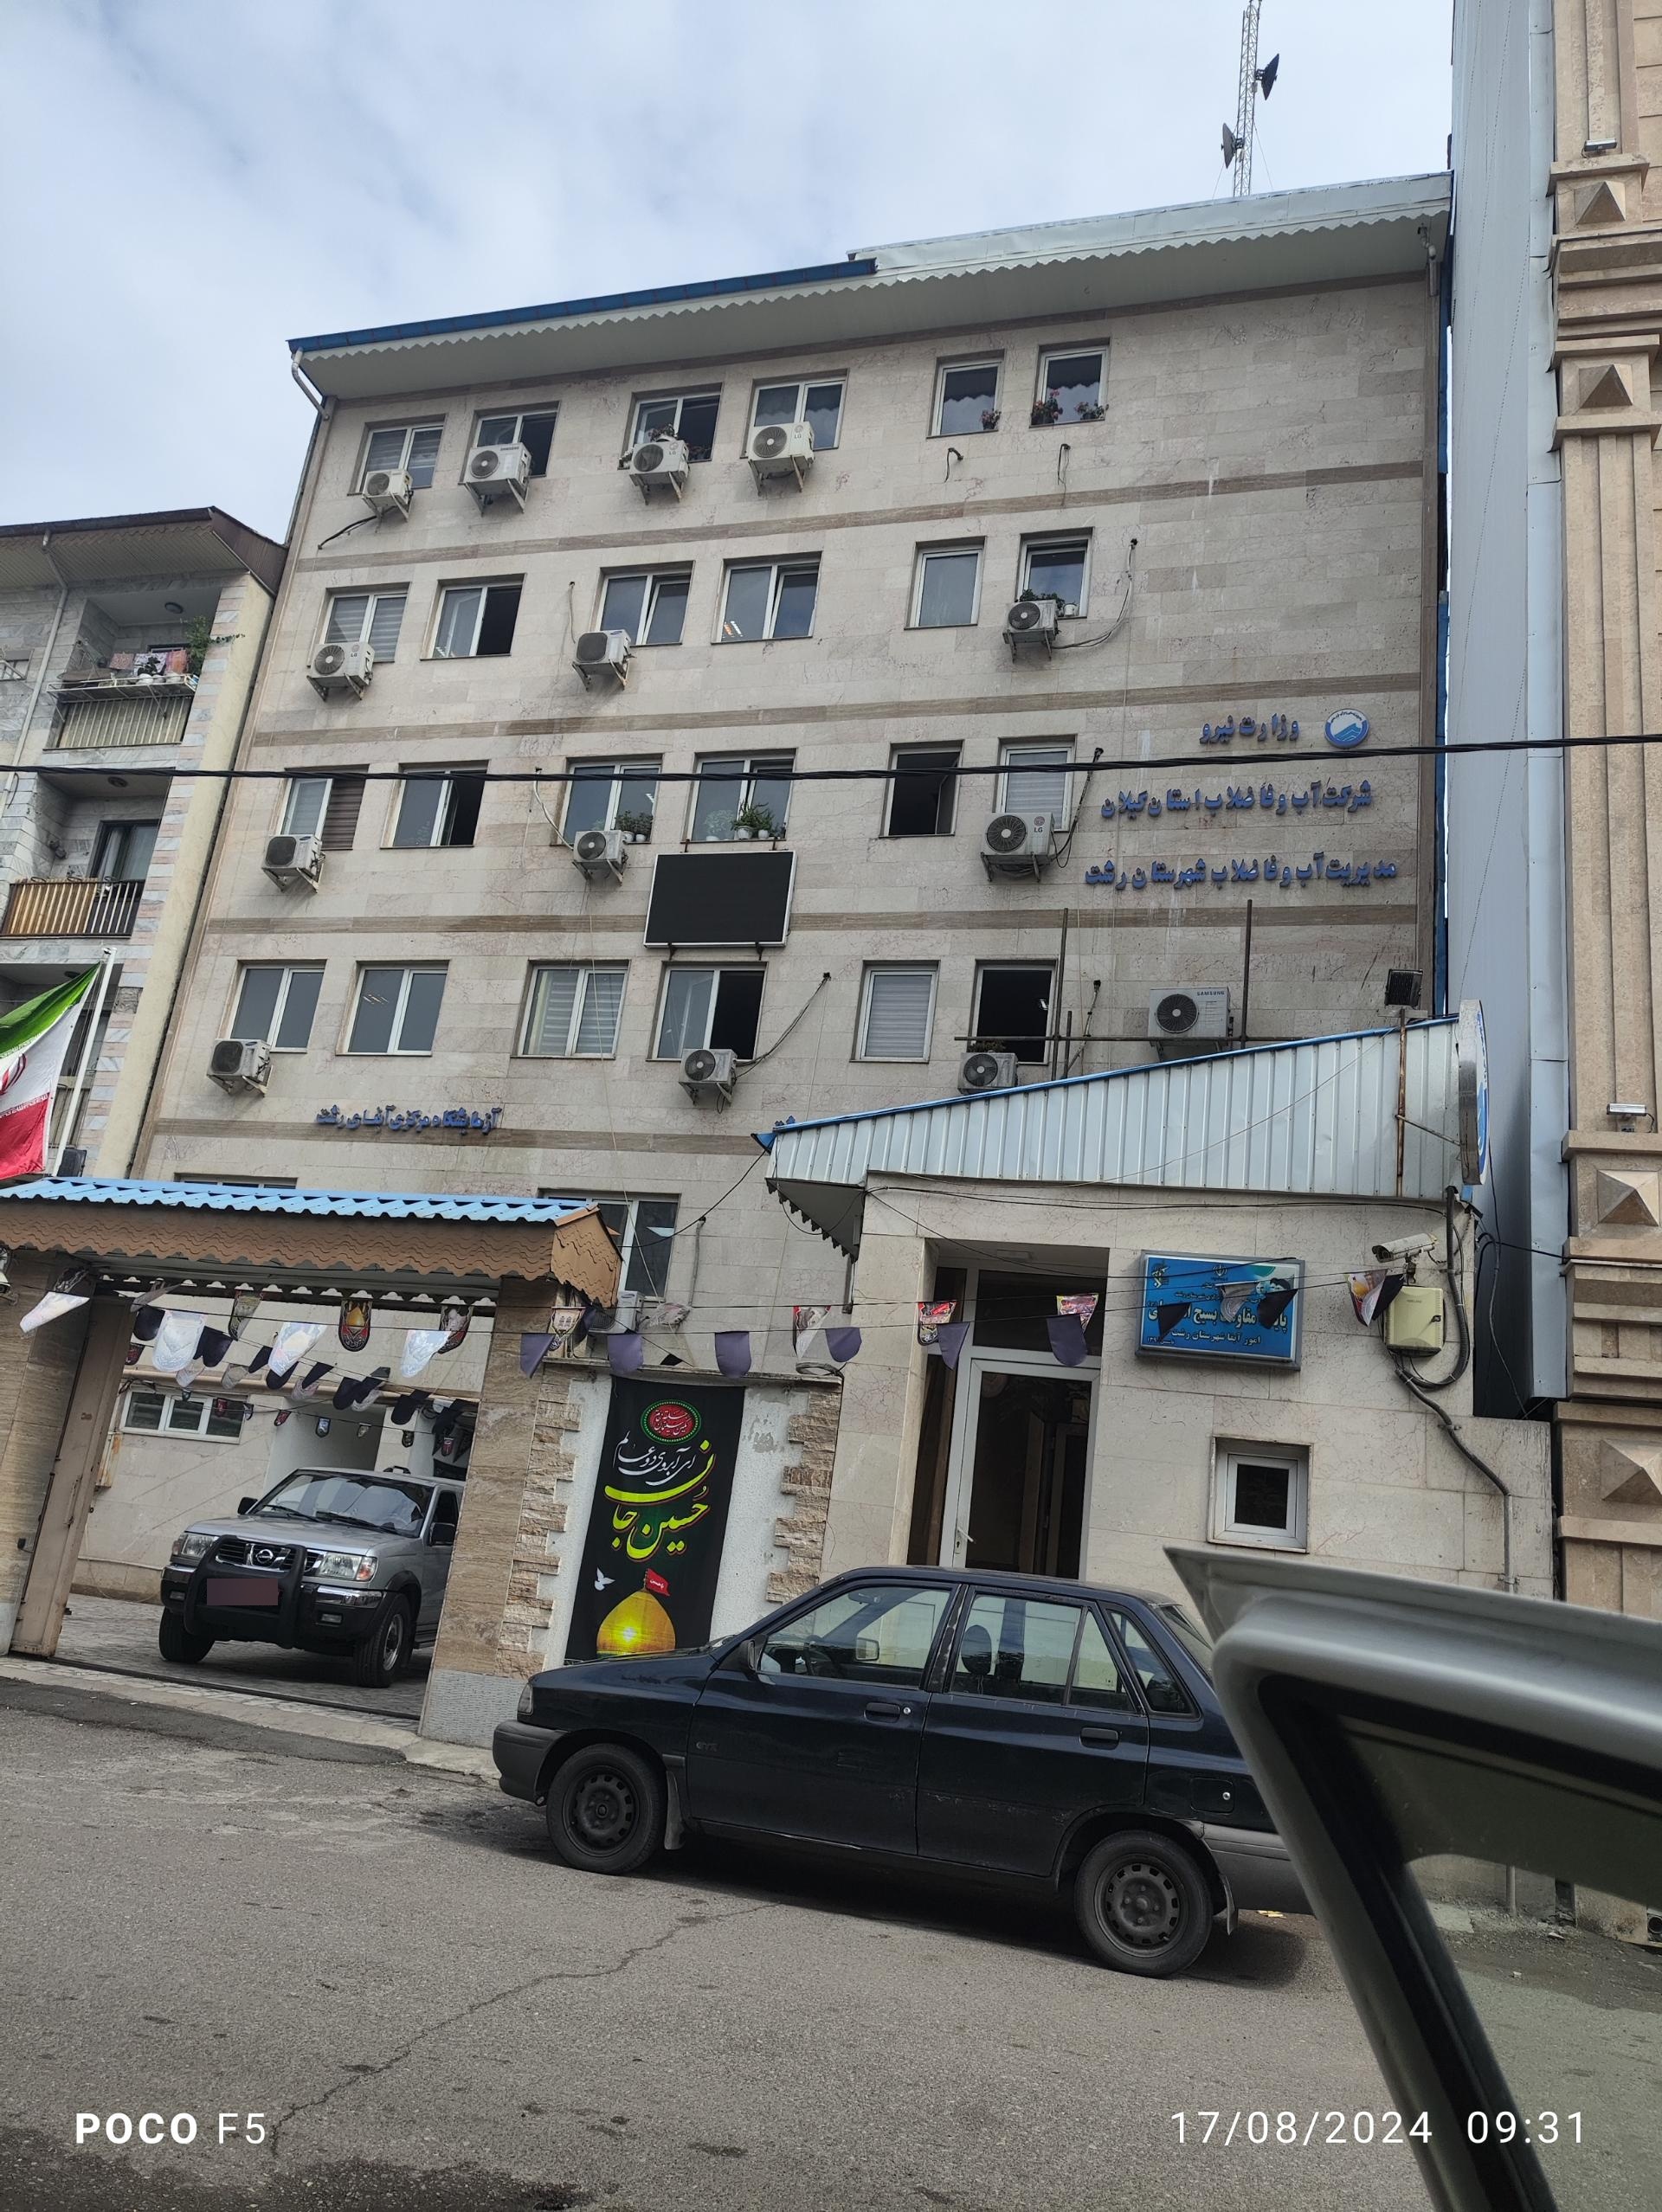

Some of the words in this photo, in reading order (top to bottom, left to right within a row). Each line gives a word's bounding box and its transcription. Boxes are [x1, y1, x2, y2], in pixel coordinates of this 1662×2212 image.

[1199, 715, 1235, 744] نیرو
[1239, 712, 1299, 742] وزارت
[1148, 788, 1201, 817] استان
[1204, 782, 1274, 817] فاضلاب
[1276, 794, 1287, 815] و
[1292, 781, 1321, 815] آب
[1322, 780, 1372, 813] شرکت
[1085, 859, 1126, 891] رشت
[1132, 858, 1206, 889] شهرستان
[1212, 854, 1278, 890] فاضلاب
[1279, 866, 1292, 888] و
[1296, 852, 1324, 888] آب
[1325, 858, 1397, 887] مدیریت
[316, 1104, 345, 1129] رشت
[433, 1107, 502, 1135] آزمایشگاه
[1194, 1308, 1218, 1325] بسیج
[1171, 1328, 1190, 1340] رشت
[1192, 1330, 1225, 1342] شهرستان
[612, 1431, 655, 1469] عالم
[618, 1445, 692, 1476] آبروی
[645, 1454, 697, 1486] ای
